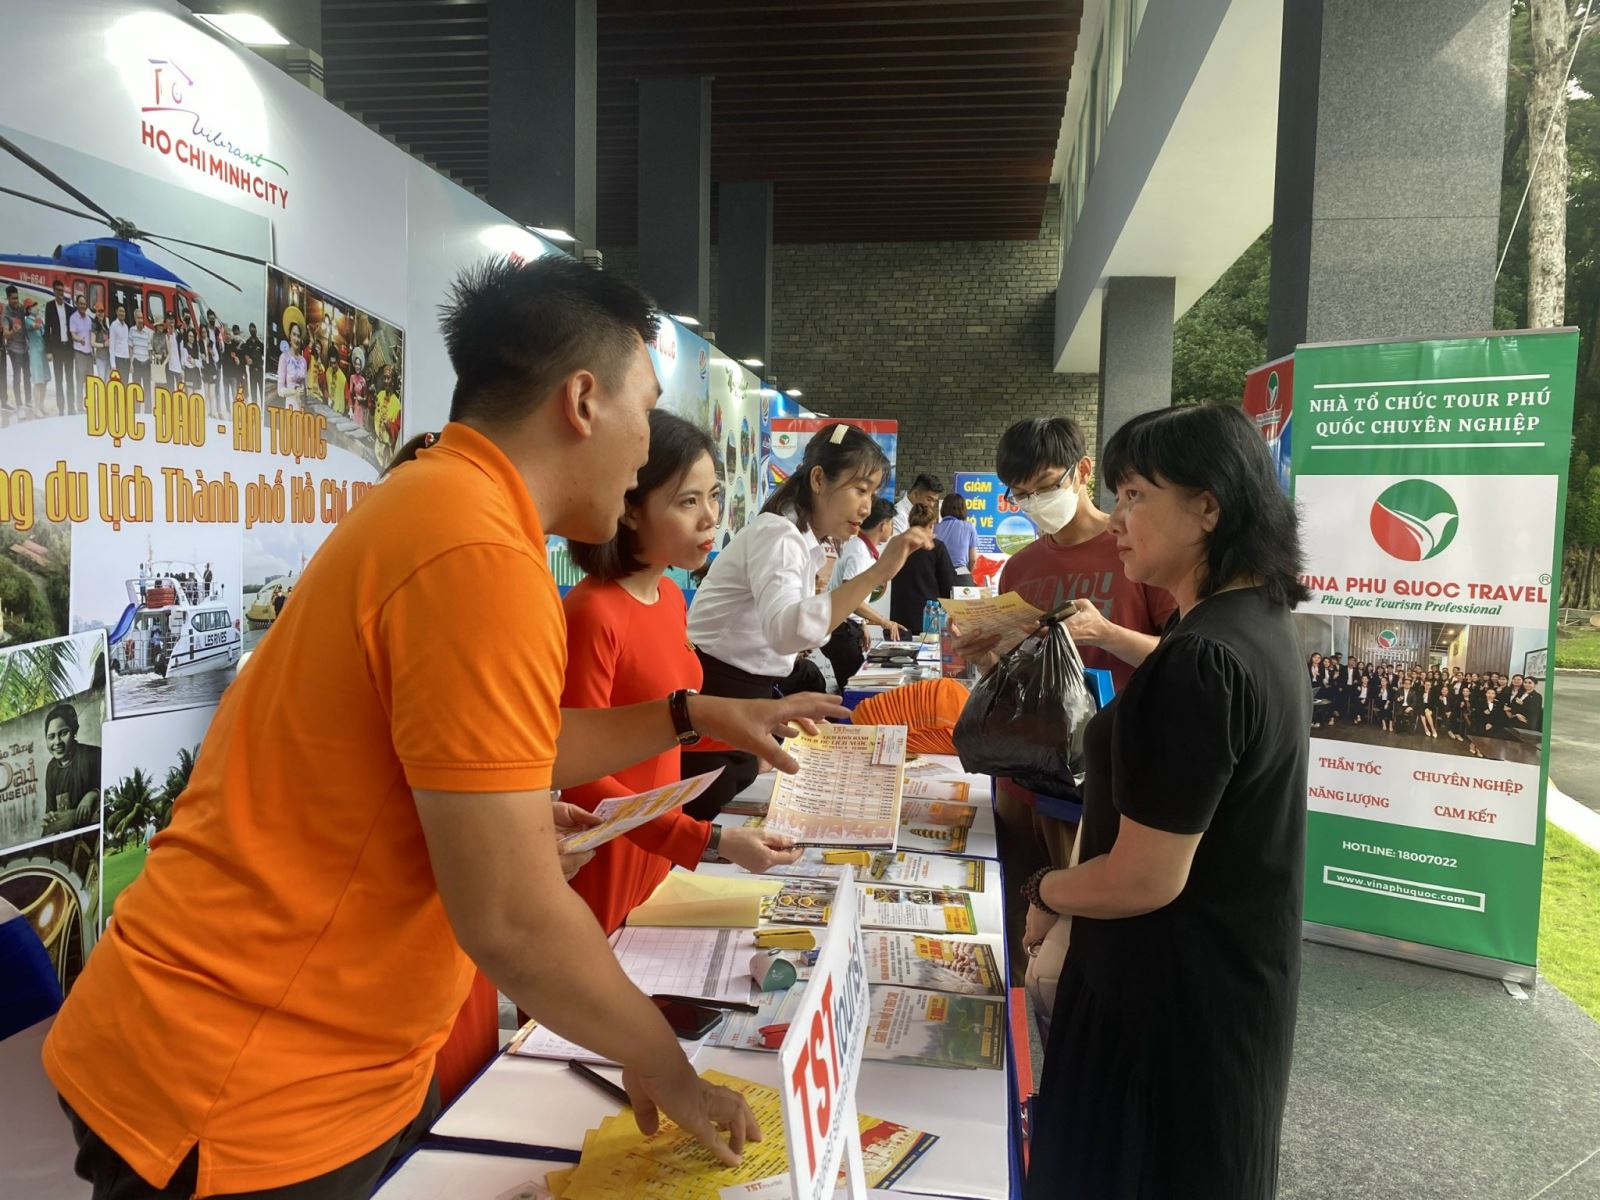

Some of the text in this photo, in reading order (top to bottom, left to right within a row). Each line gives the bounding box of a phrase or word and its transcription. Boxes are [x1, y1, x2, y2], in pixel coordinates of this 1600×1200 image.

[141, 120, 289, 209] HO CHI MINH CITY
[1309, 386, 1551, 413] NHÀ TỔ CHỨC TOUR PHÚ
[84, 369, 145, 448] ĐỘC
[267, 404, 327, 464] TƯỢNG
[1316, 412, 1540, 437] QUỐC CHUYÊN NGHIỆP
[45, 460, 89, 522] du
[98, 462, 153, 531] lịch
[161, 467, 239, 523] Thành
[245, 469, 285, 529] phố
[290, 471, 315, 523] Hồ
[321, 478, 347, 523] Chí
[963, 478, 992, 492] GIẢM
[1299, 575, 1339, 592] INA
[1346, 576, 1387, 594] PHU
[1393, 579, 1460, 598] QUOC
[1467, 583, 1548, 603] TRAVEL
[1320, 594, 1502, 615] Phu Quoc Tourism Professional
[1356, 760, 1382, 775] TỐC
[1413, 770, 1470, 787] CHUYÊN
[1308, 786, 1390, 808] NĂNG LƯỢNG
[1434, 805, 1497, 824] CAM KẾT
[1342, 840, 1458, 868] HOTLINE: 18007022
[1336, 874, 1465, 904] www.vinaphuquoc.com
